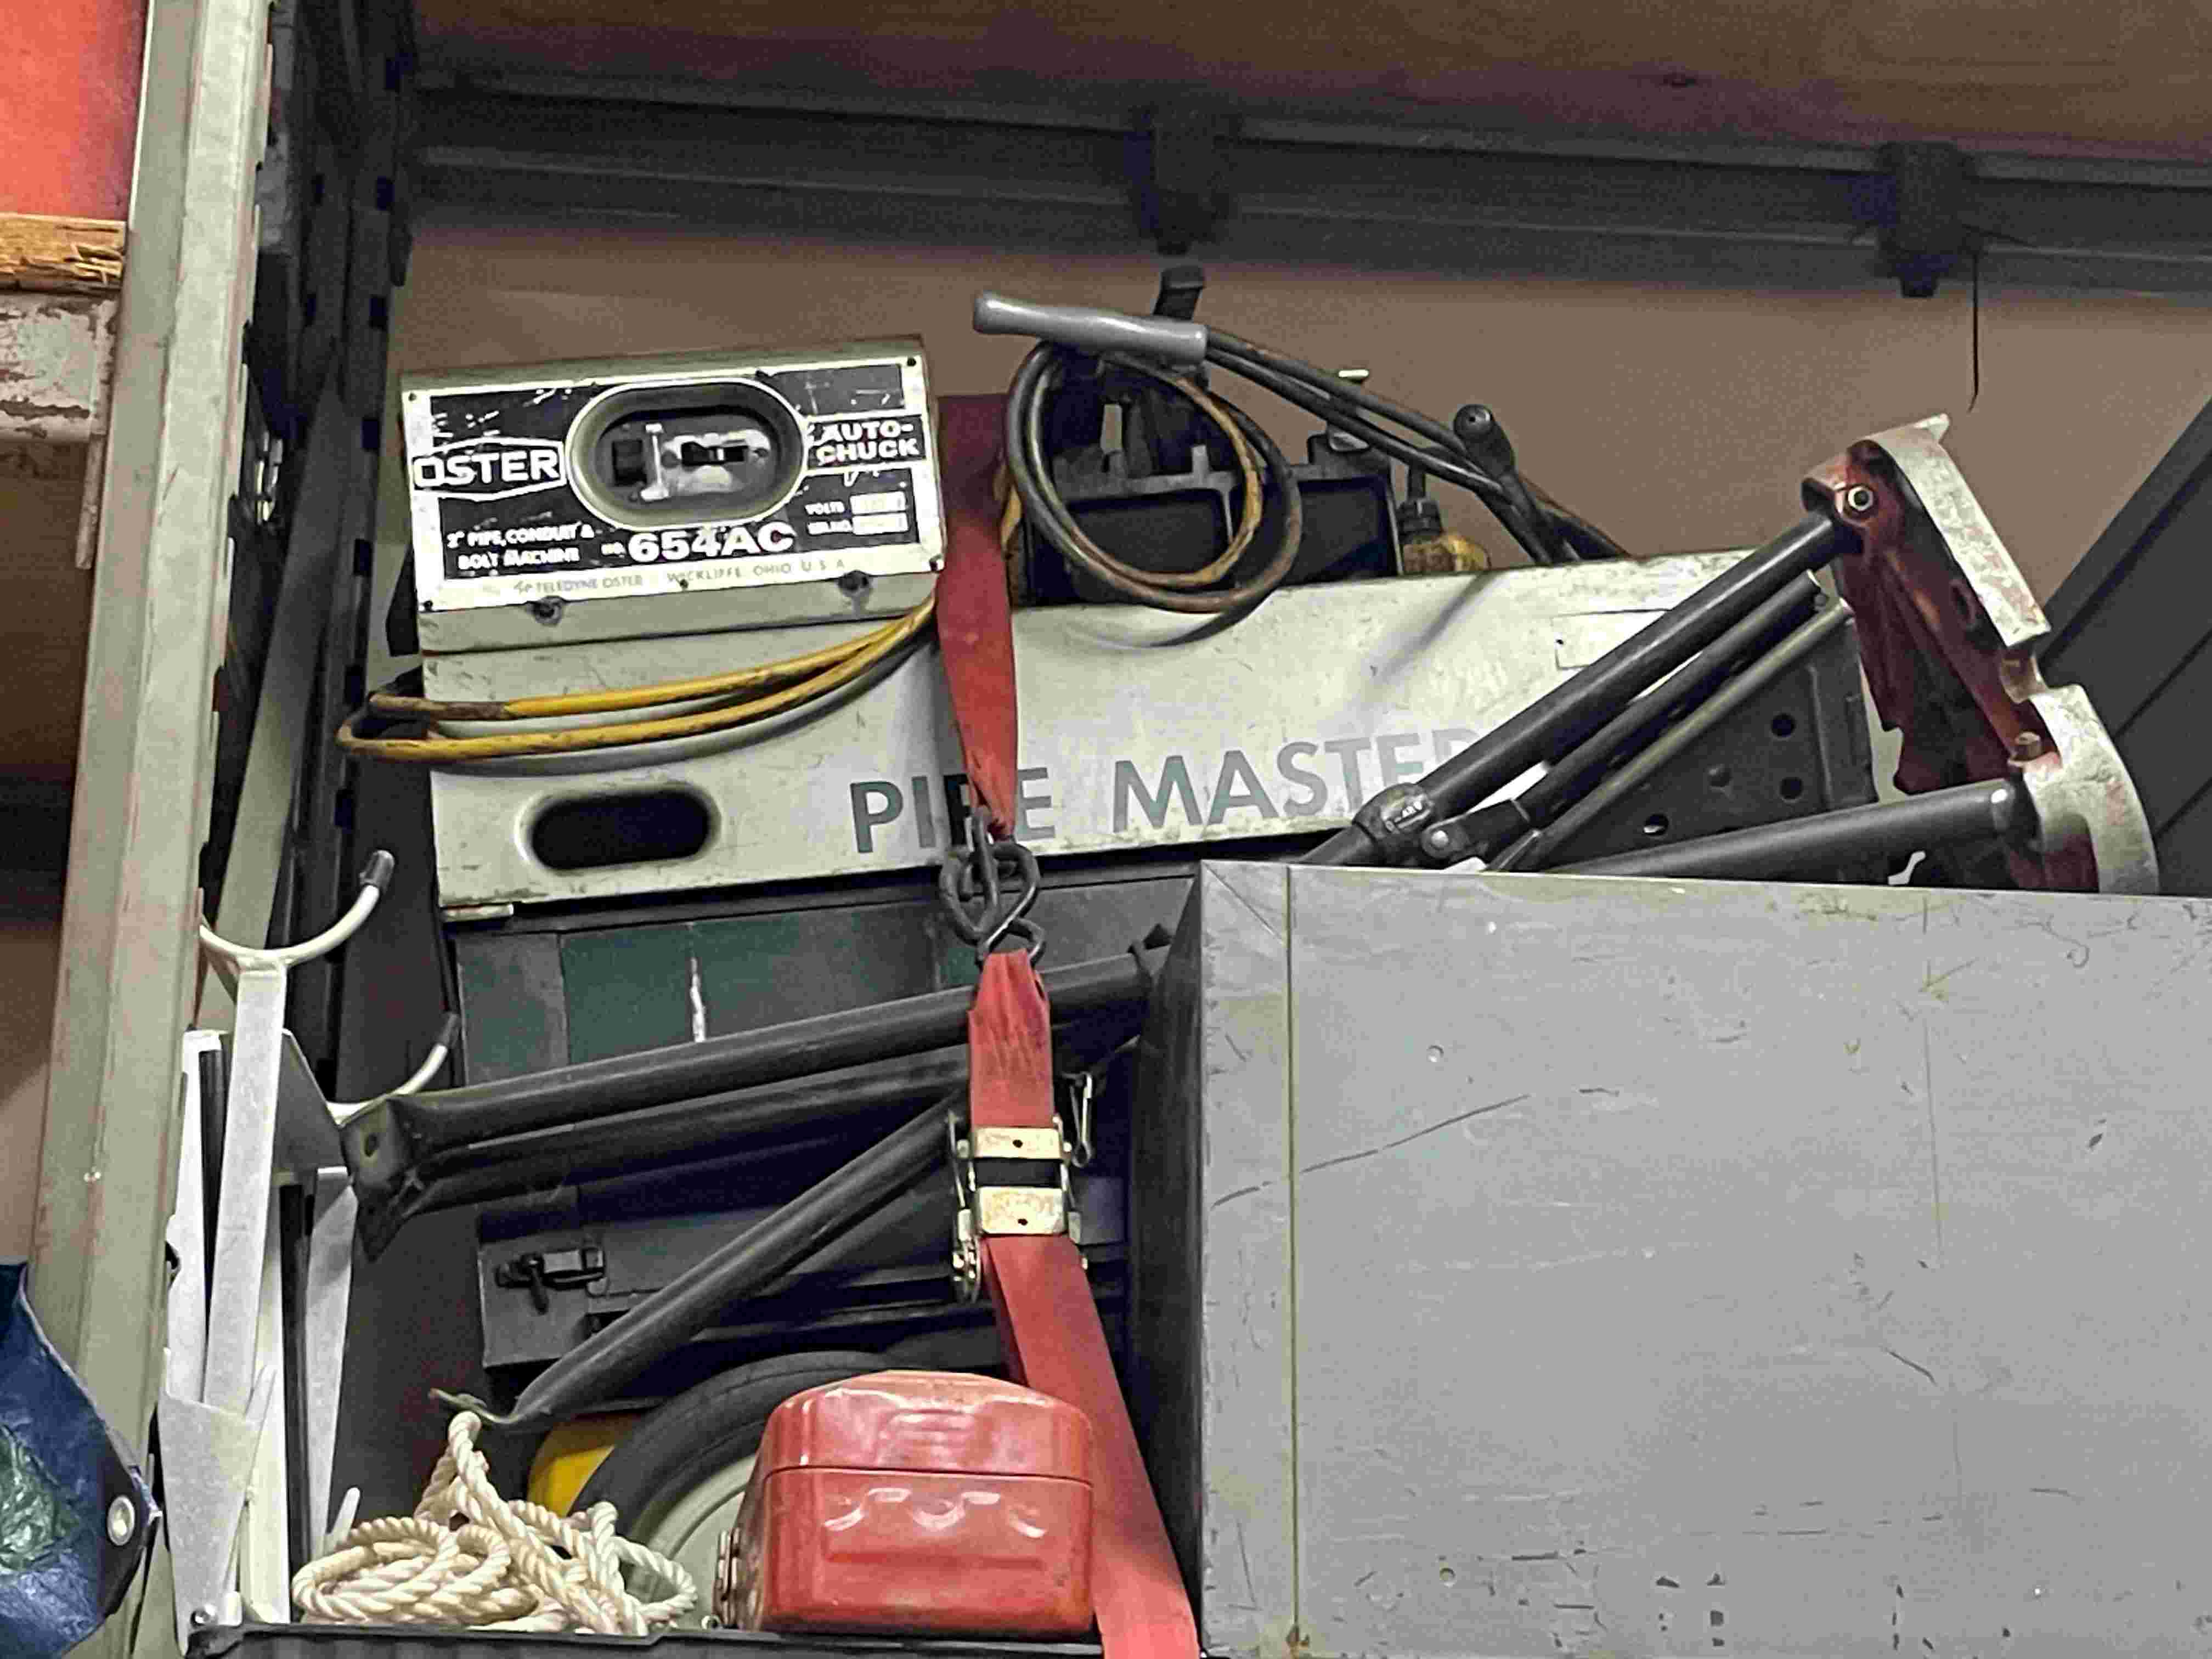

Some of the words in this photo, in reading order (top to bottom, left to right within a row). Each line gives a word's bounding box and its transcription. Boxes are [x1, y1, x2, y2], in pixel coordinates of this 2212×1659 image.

[819, 420, 913, 443] AUTO-
[816, 438, 920, 465] CHUCK
[414, 449, 560, 487] OSTER
[629, 521, 796, 562] 654AC
